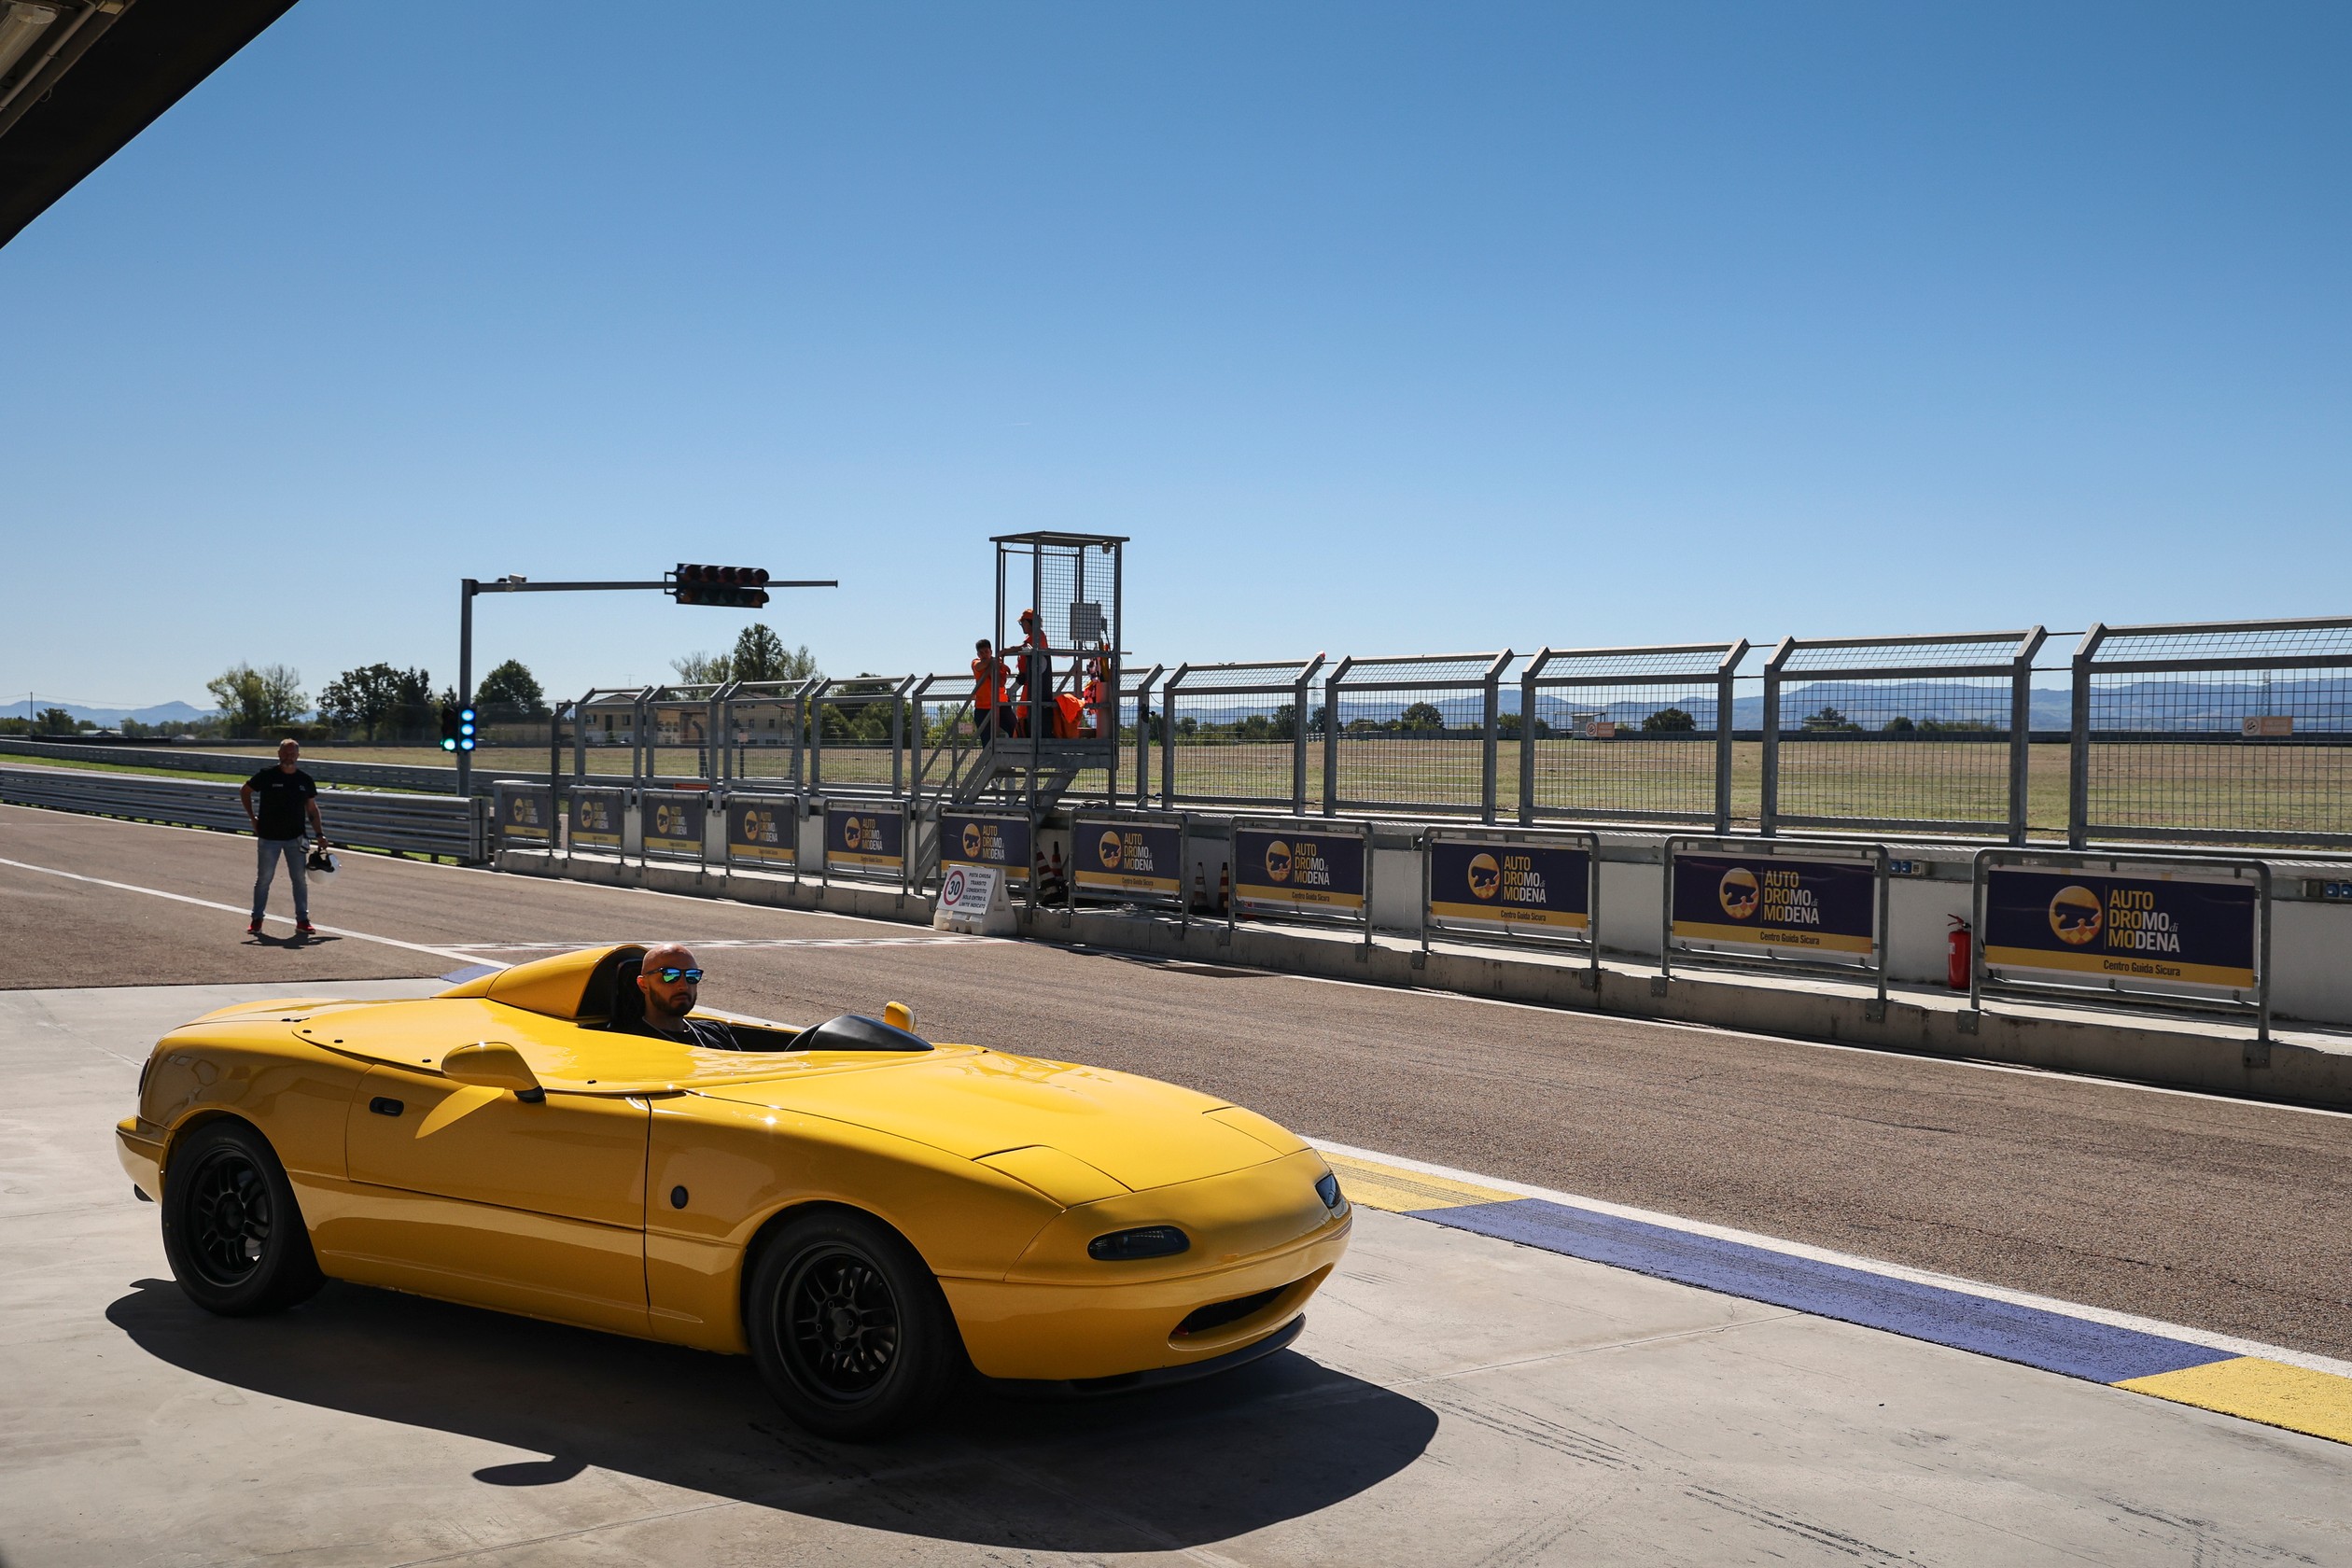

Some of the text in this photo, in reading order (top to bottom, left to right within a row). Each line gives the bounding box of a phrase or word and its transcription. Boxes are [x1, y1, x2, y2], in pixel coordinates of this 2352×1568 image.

[983, 825, 998, 836] AUTO
[983, 836, 1001, 847] DROMO
[1124, 833, 1142, 845] AUTO
[983, 848, 1004, 860] MODENA
[1124, 846, 1148, 859] DROMO
[1295, 843, 1317, 857] AUTO
[1124, 858, 1154, 871] MODENA
[1295, 856, 1324, 871] DROMO
[1504, 855, 1531, 871] AUTO
[1294, 870, 1330, 885] MODENA
[1504, 871, 1540, 887] DROMO
[1765, 870, 1799, 888] AUTO
[948, 880, 960, 895] 30
[1504, 887, 1547, 903] MODENA
[1764, 888, 1812, 906] DROMO
[2109, 889, 2154, 910] AUTO
[1501, 910, 1547, 921] Centro Guida Sicura
[1764, 905, 1820, 925] MODENA
[2109, 909, 2179, 932] DROMO di
[1760, 931, 1820, 945] Centro Guida Sicura
[2108, 929, 2180, 953] MODENA
[2104, 959, 2181, 976] Centro Guida Sicura
